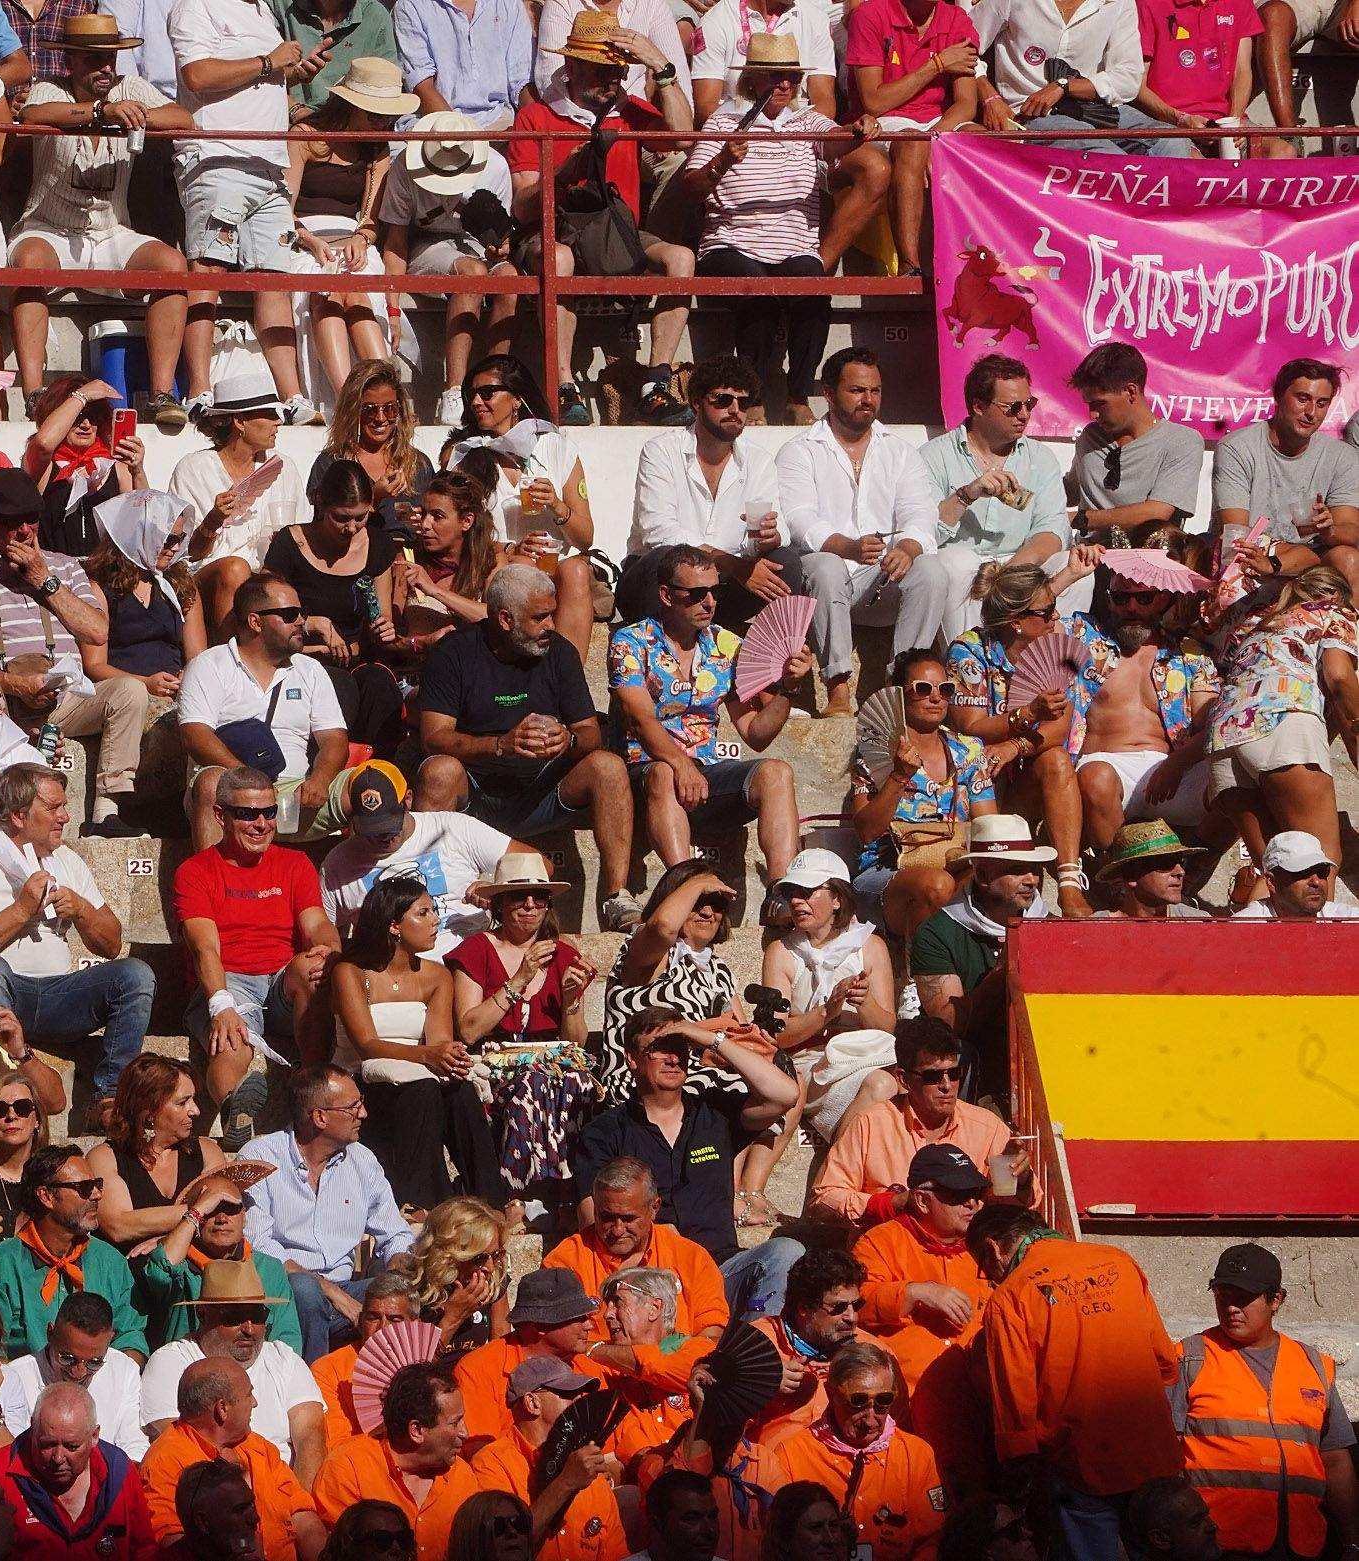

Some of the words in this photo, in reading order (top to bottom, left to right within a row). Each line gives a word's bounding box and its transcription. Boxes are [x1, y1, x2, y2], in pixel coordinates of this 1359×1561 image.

[1039, 164, 1171, 207] PEÑA
[886, 328, 909, 341] 50
[718, 743, 739, 758] 30
[129, 860, 153, 875] 25
